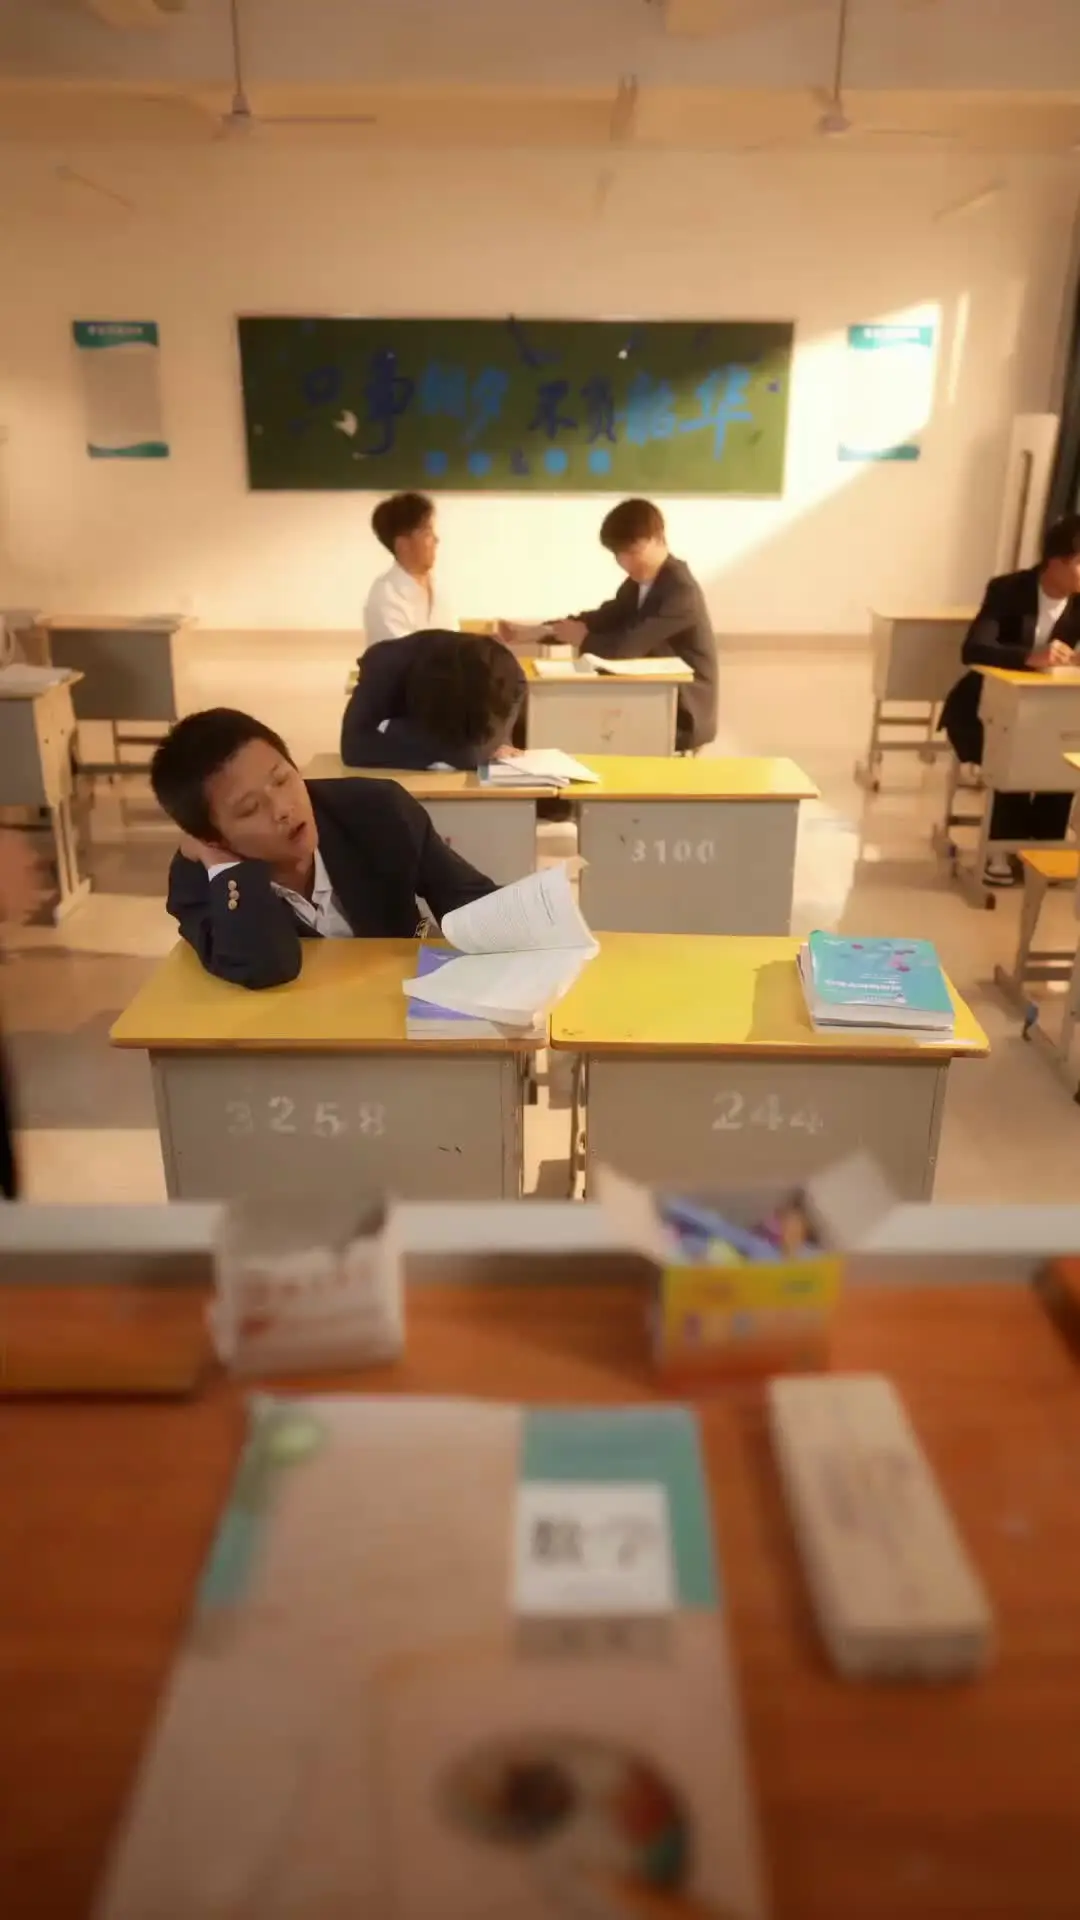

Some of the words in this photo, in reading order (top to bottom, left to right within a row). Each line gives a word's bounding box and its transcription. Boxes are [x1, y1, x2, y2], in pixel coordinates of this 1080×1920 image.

[630, 837, 717, 866] 3100
[224, 1095, 387, 1139] 3258
[710, 1089, 824, 1136] 244
